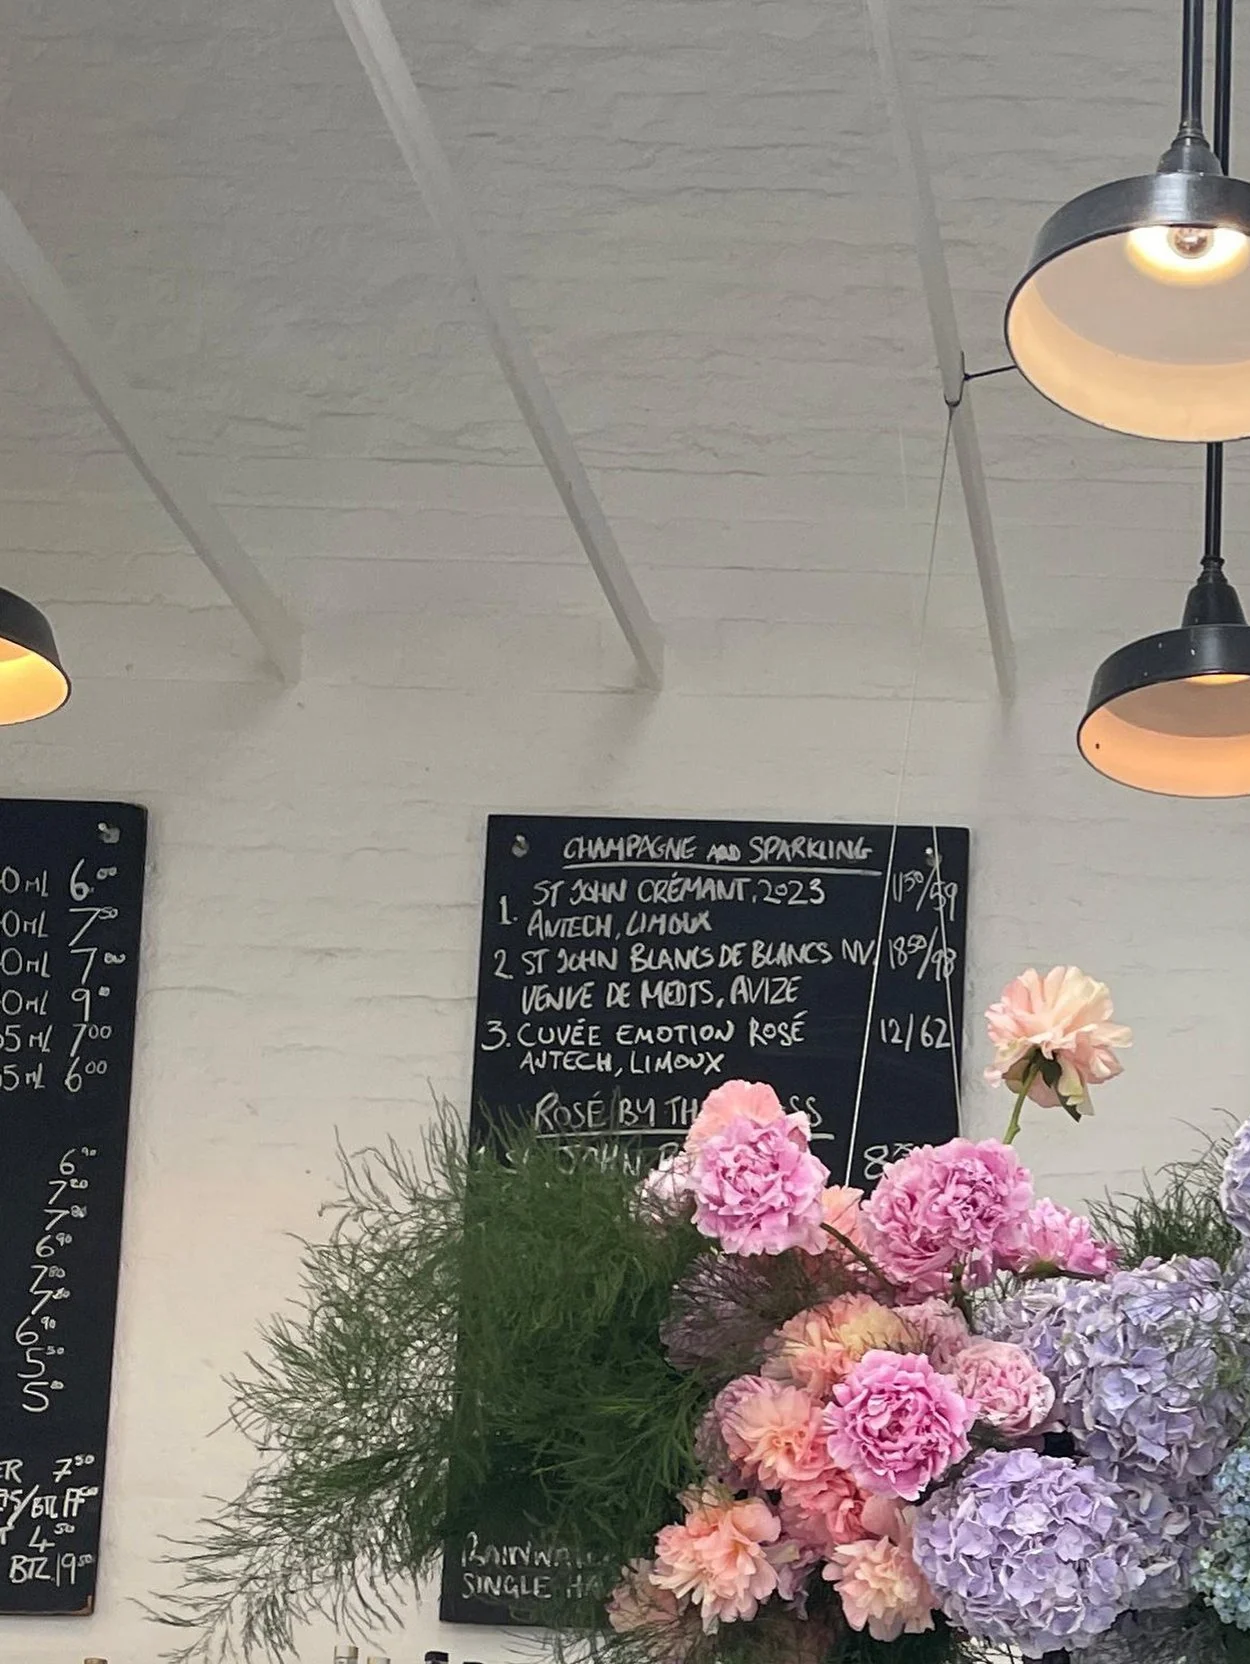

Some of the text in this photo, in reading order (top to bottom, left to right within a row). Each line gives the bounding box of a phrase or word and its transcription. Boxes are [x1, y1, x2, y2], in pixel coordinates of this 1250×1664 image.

[562, 834, 698, 862] CHAMPAGNE
[747, 836, 874, 863] SPARKLING
[532, 877, 827, 907] ST JOHN 2023
[526, 910, 713, 941] ANTECH, LIMOUX
[520, 937, 835, 978] ST JOHN BLANCS DE BLANCS
[606, 976, 803, 1009] DE AVIZE
[480, 1010, 951, 1052] 3. CUVÉE EMOTION ROSÉ 12/62
[519, 1050, 726, 1077] ANTECH, LIMOUX
[535, 1090, 699, 1132] ROSÉ BY TH
[461, 1572, 553, 1600] SINGLE
